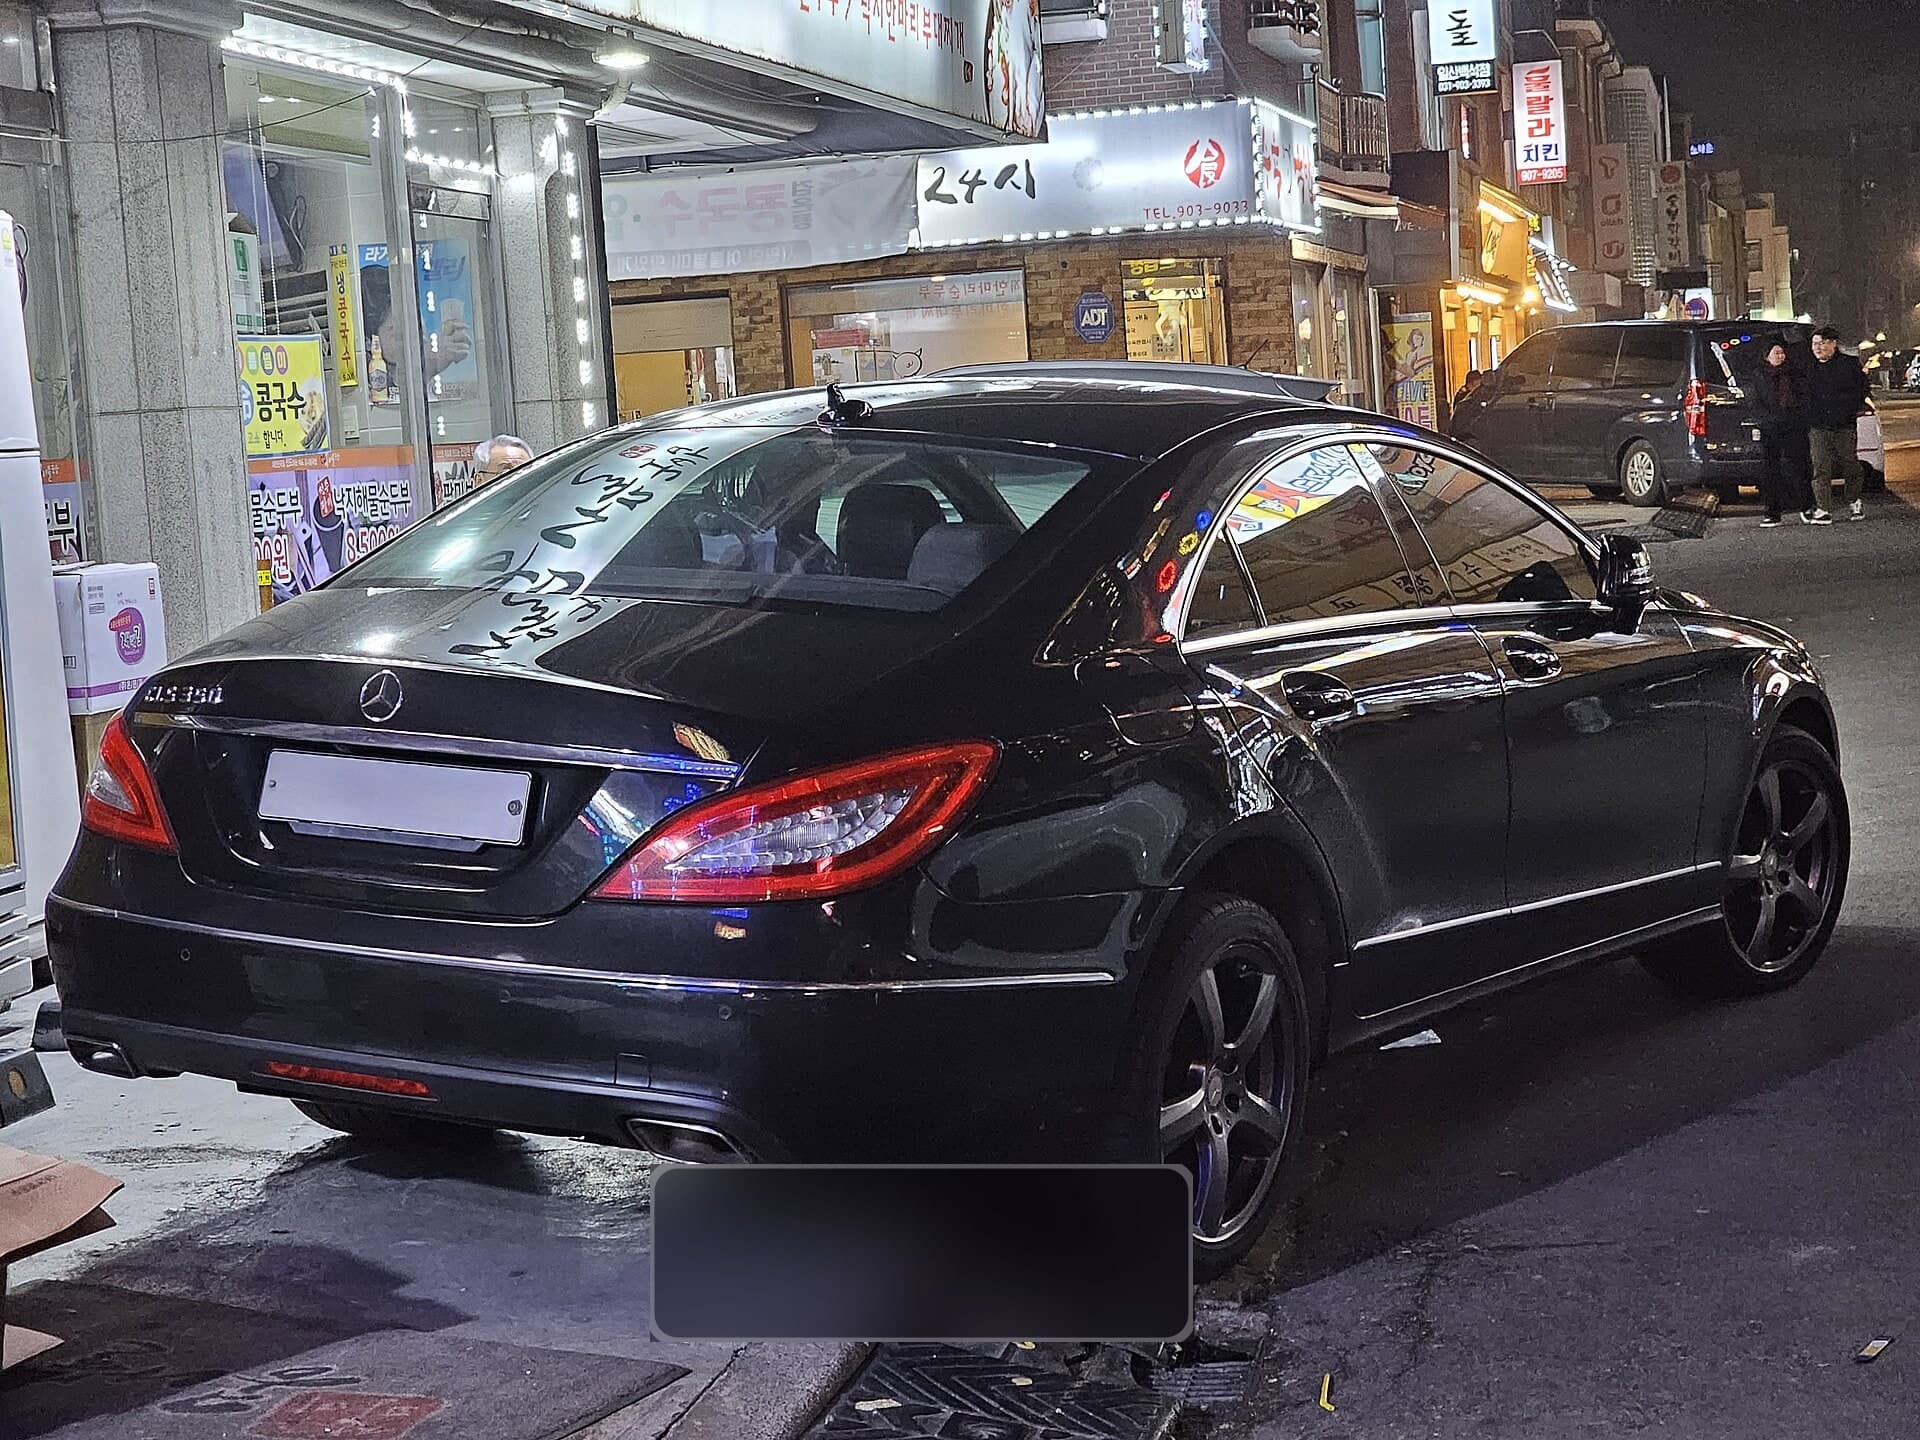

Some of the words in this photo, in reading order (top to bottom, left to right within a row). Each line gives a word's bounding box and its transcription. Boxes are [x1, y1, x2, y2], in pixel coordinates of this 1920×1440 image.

[1523, 143, 1559, 163] 치킨
[924, 158, 1035, 205] 24시
[1521, 167, 1563, 182] 907-9205
[1142, 199, 1249, 221] TEL.903-9033
[336, 271, 352, 369] 냉콩국수
[1080, 308, 1107, 327] ADT
[256, 381, 307, 422] 콩국수
[334, 482, 411, 520] 낙지해물순두부
[45, 501, 75, 553] 부
